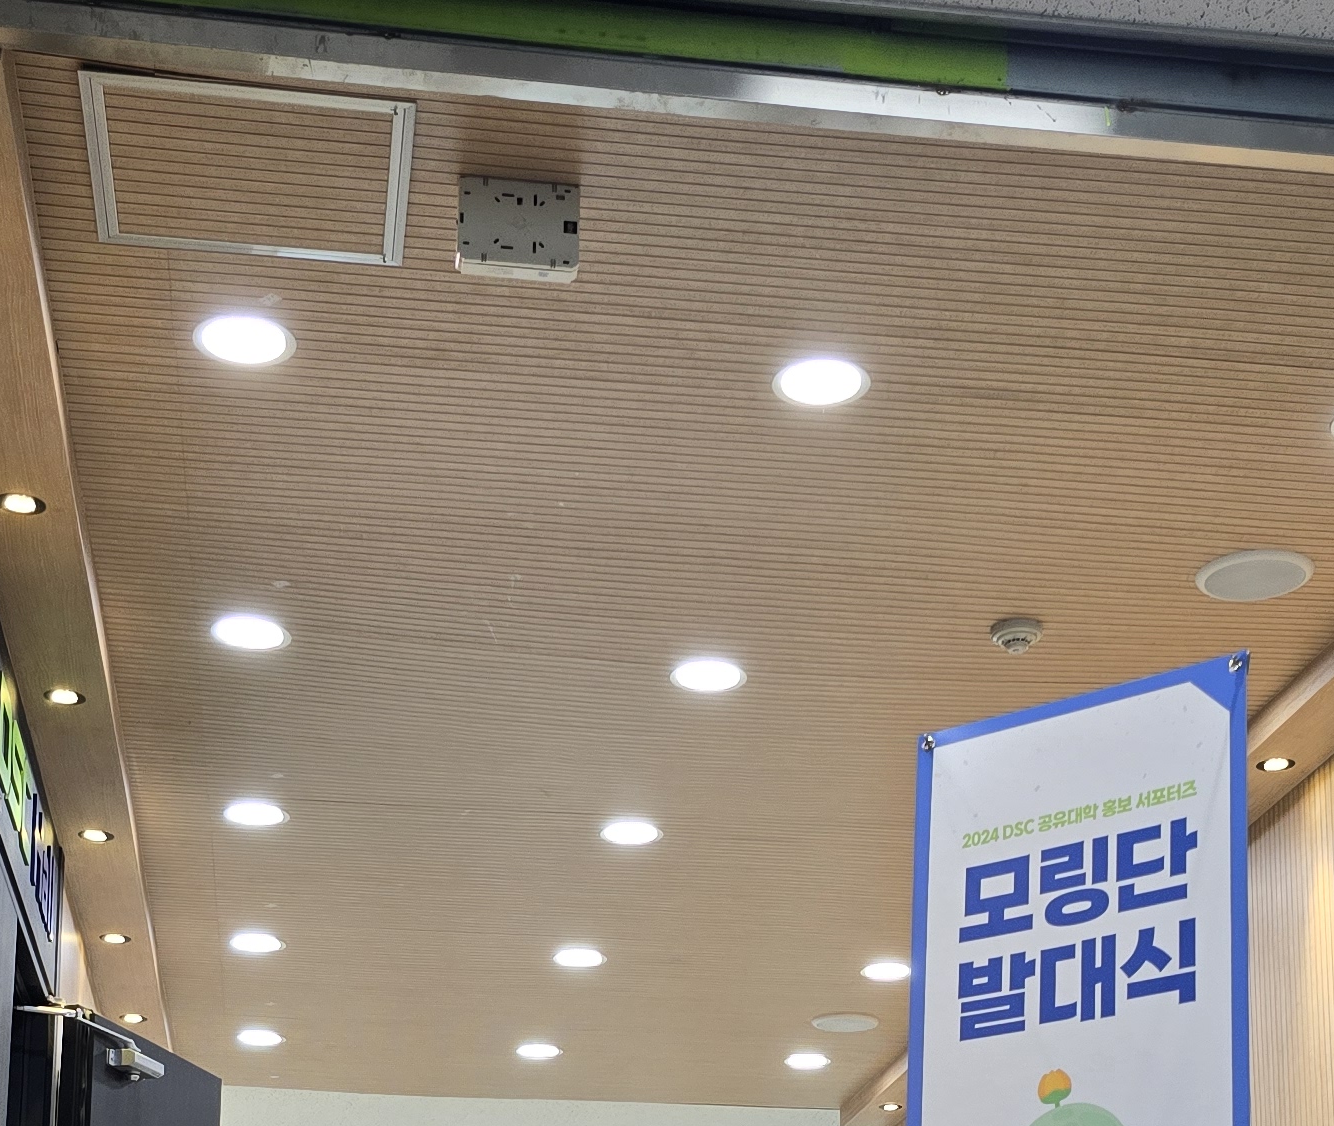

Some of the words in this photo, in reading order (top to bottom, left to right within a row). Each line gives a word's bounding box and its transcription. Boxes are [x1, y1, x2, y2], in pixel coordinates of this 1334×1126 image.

[962, 829, 999, 849] 2024
[1003, 818, 1035, 842] DSC
[1037, 805, 1097, 833] 공유대학
[1102, 795, 1133, 816] 홍보
[1136, 780, 1198, 809] 서포터즈
[958, 817, 1198, 943] 모링단
[958, 917, 1197, 1042] 발대식
